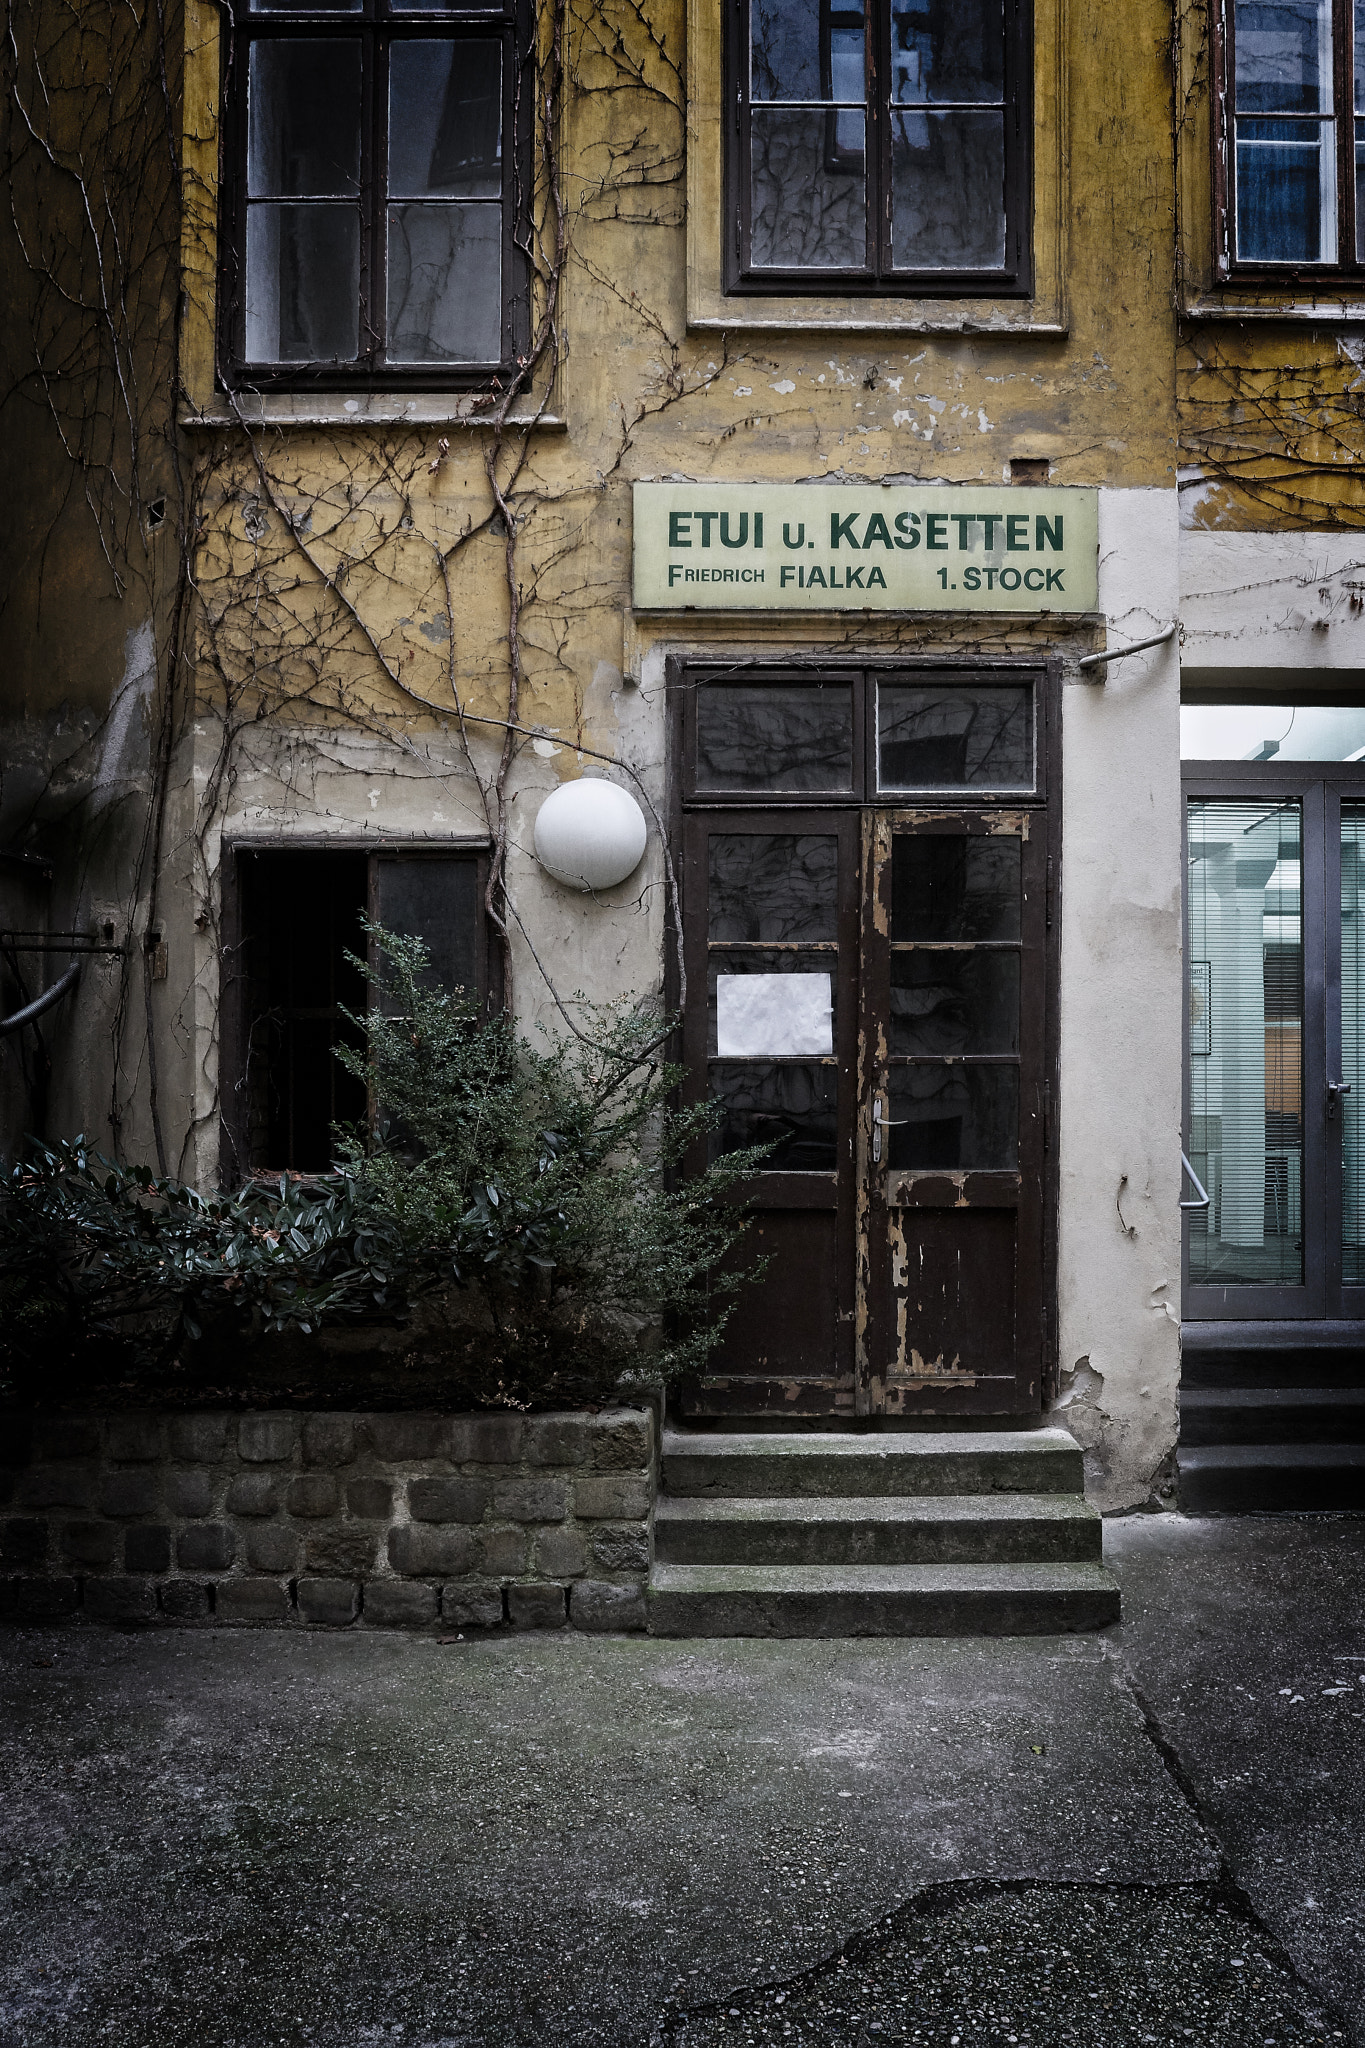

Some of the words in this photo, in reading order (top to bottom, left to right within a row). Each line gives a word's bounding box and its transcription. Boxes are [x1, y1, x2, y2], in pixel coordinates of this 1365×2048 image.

[668, 511, 764, 549] ETUI
[782, 522, 815, 550] u.
[830, 511, 1064, 552] KASETTEN
[668, 564, 765, 588] FRIEDRICH
[779, 565, 888, 589] FIALKA
